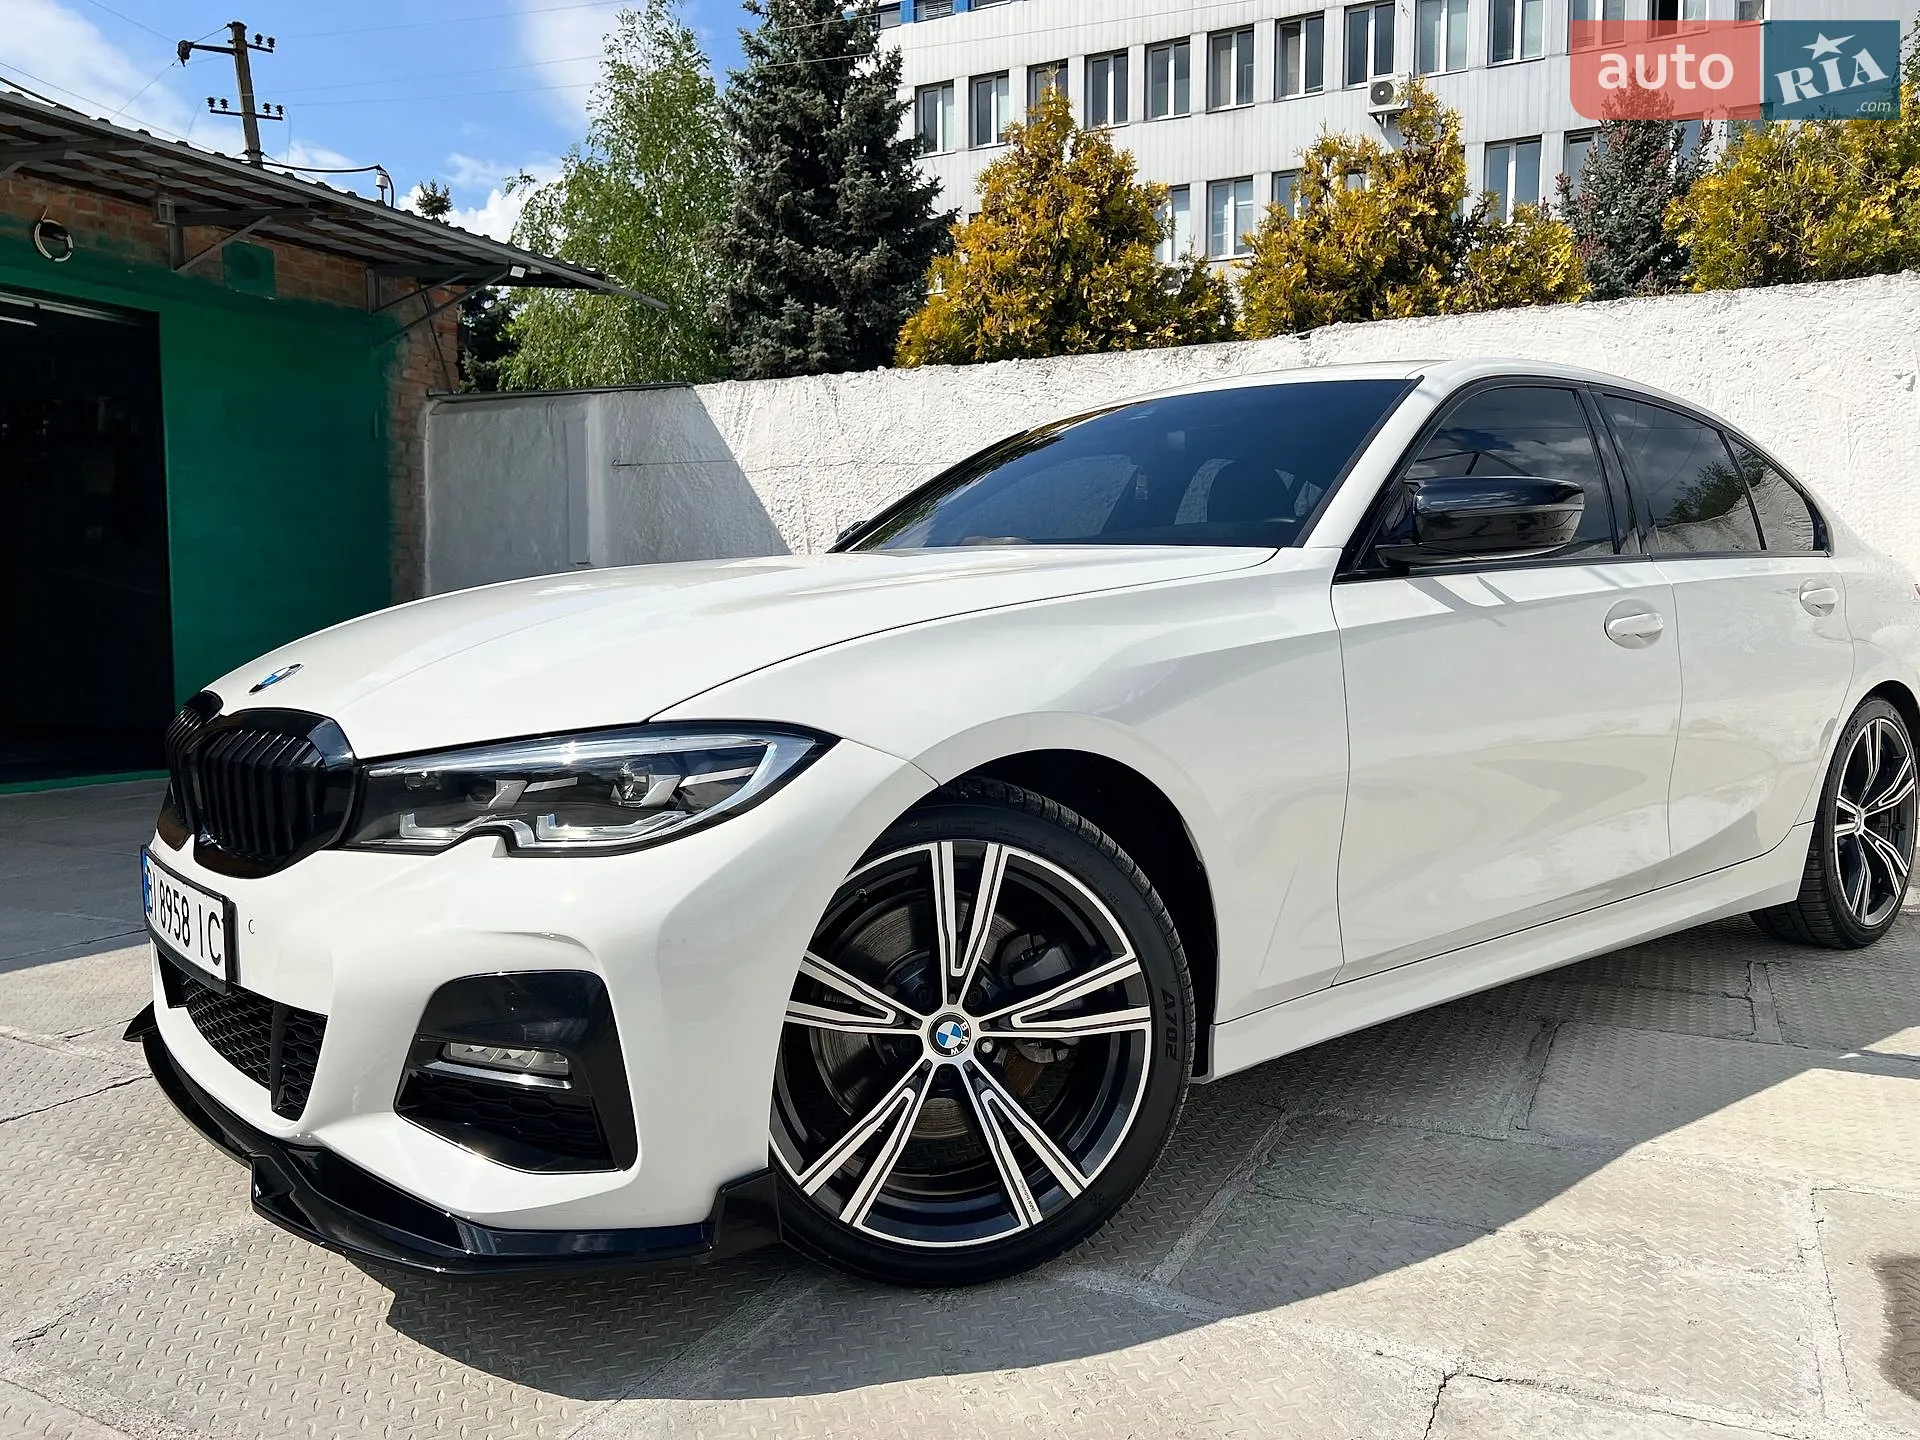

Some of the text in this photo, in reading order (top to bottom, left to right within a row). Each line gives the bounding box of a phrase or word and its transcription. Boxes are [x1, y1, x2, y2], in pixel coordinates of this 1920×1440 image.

[160, 880, 190, 947] 8958
[199, 904, 221, 966] IC
[1161, 986, 1178, 1060] A702
